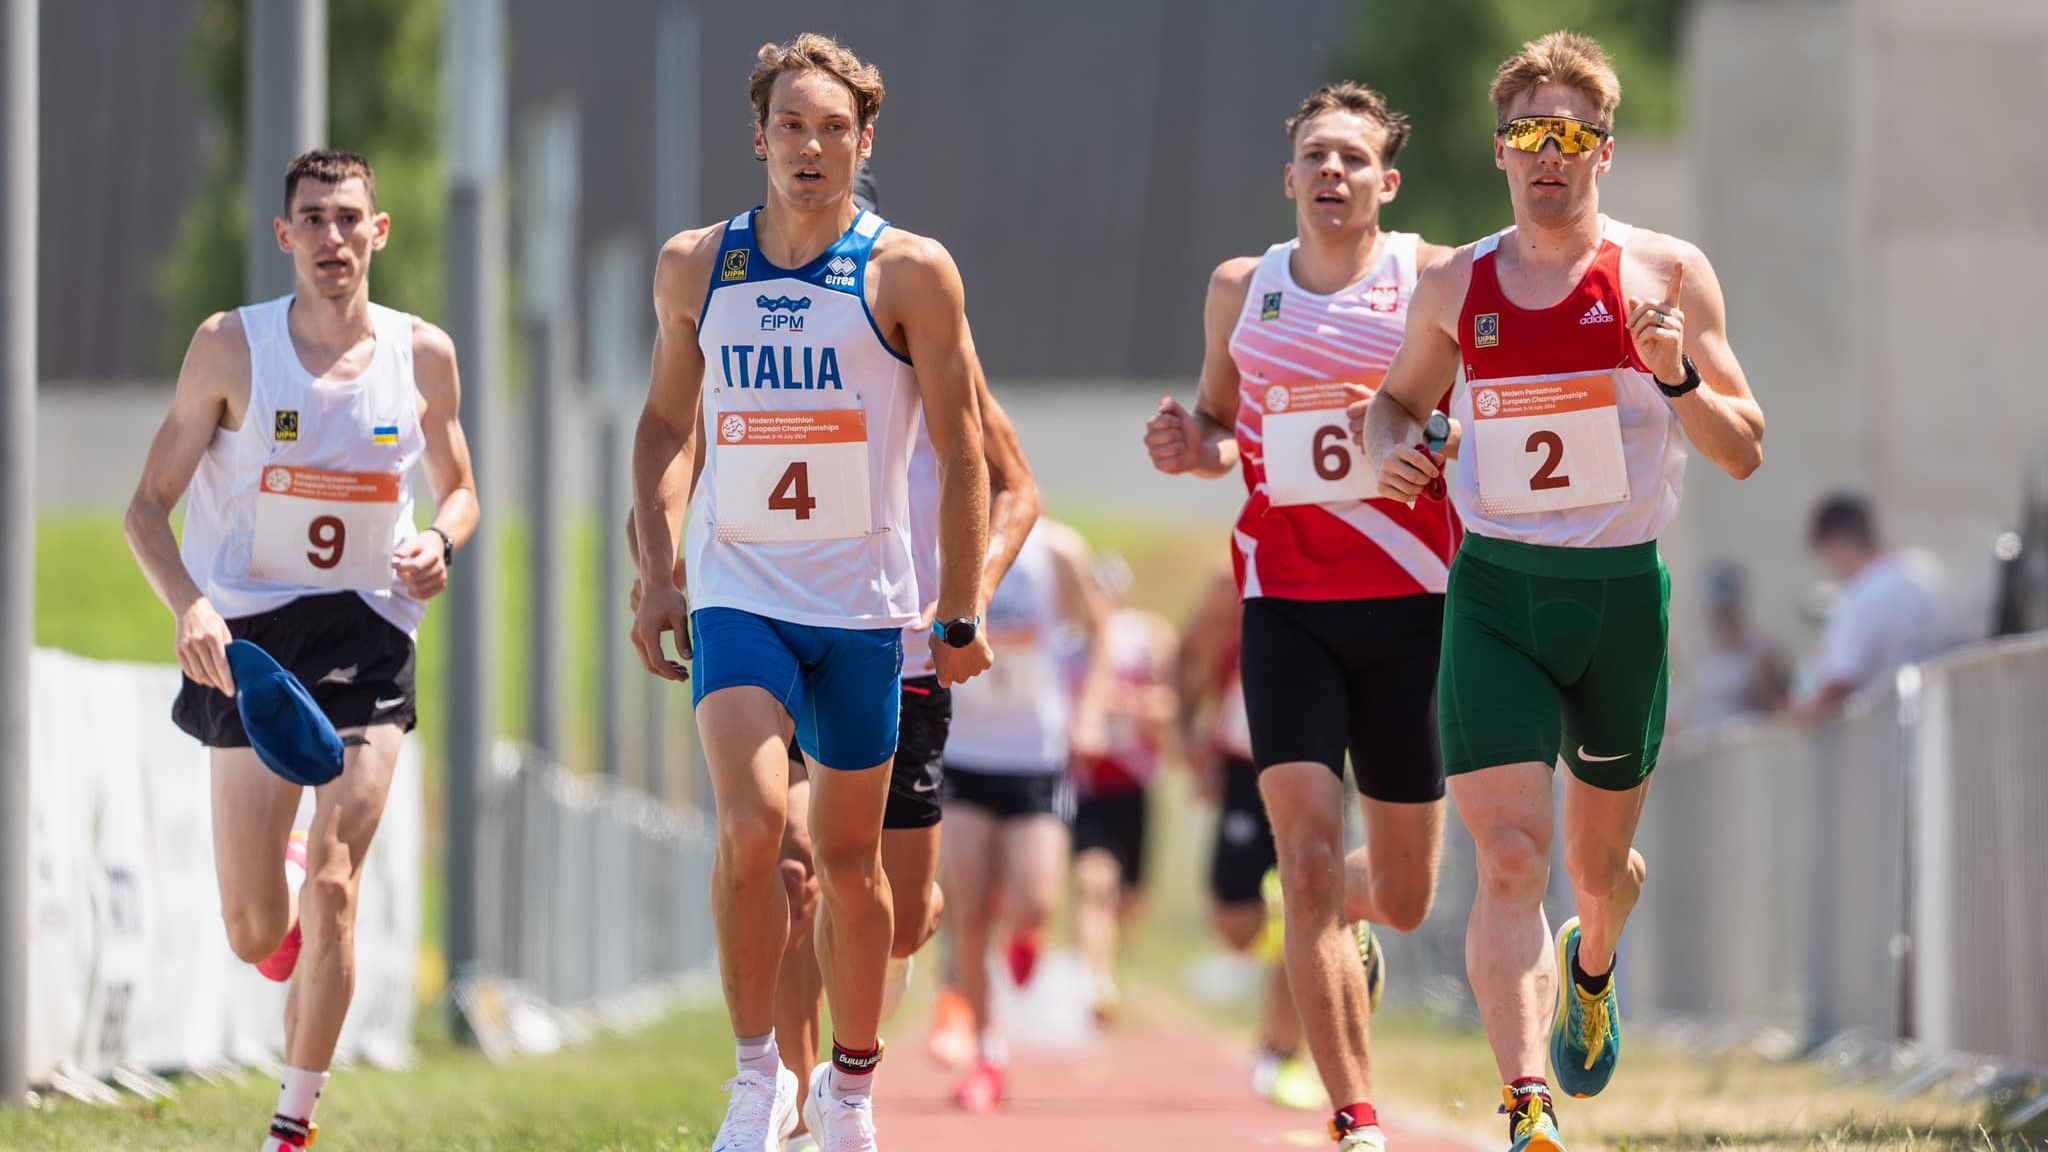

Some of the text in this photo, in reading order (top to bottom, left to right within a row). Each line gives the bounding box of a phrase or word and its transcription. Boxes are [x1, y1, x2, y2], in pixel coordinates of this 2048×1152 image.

[724, 270, 745, 279] UIPM
[825, 274, 855, 286] errea
[761, 315, 804, 329] FIPM
[1580, 314, 1613, 325] adidas
[1477, 335, 1496, 343] UIPM
[721, 345, 842, 390] ITALIA
[1525, 386, 1562, 395] Pentathlon
[1502, 391, 1588, 405] European Championships
[748, 424, 839, 433] European Championships
[1313, 425, 1351, 480] 6
[1525, 430, 1570, 490] 2
[768, 462, 816, 519] 4
[307, 516, 345, 569] 9
